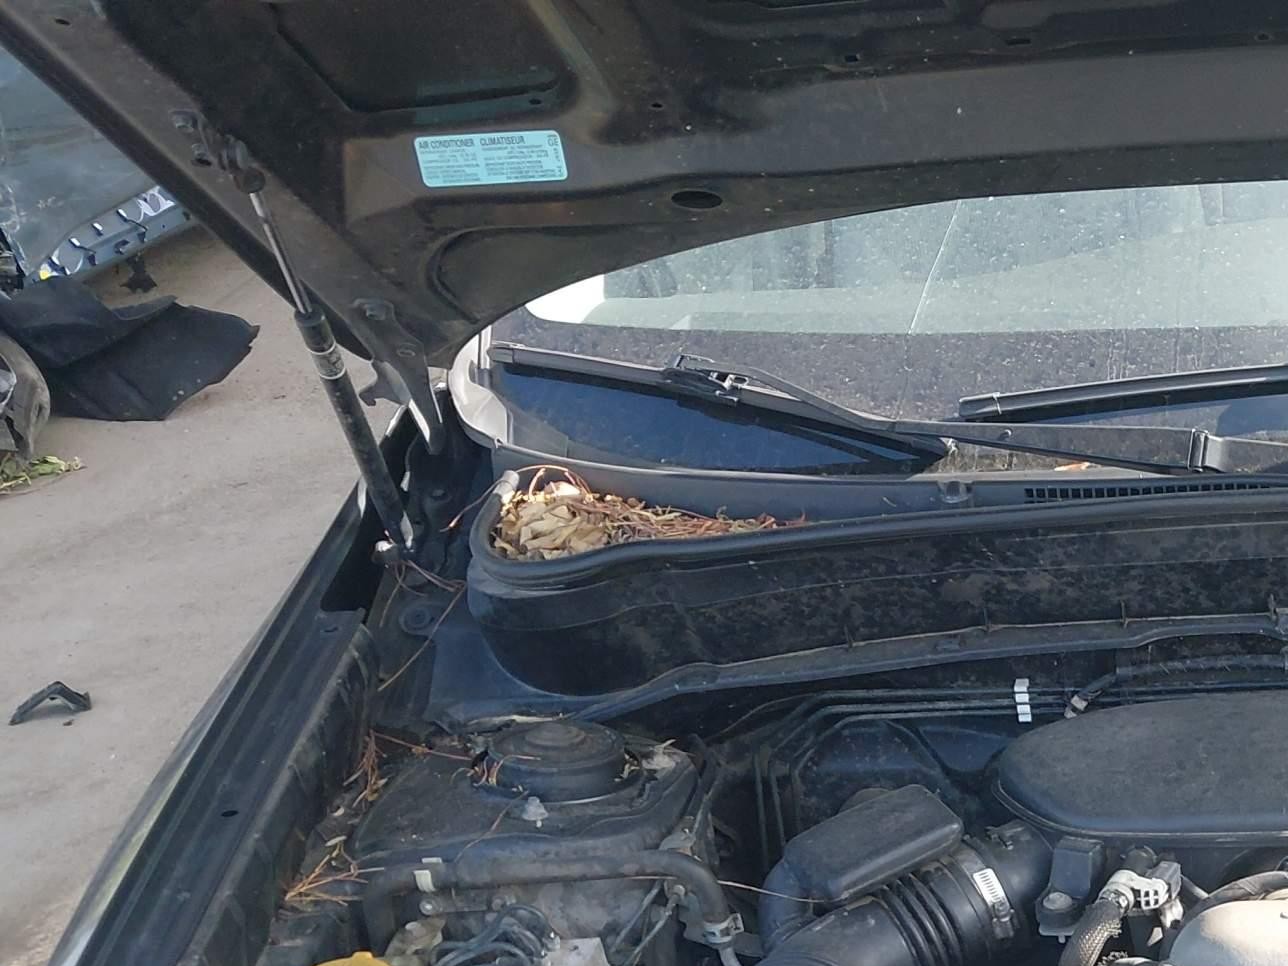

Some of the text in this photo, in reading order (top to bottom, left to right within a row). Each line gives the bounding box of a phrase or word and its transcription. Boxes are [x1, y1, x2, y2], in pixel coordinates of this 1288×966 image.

[419, 138, 475, 149] AIR CONDITIONER
[479, 135, 526, 146] CLIMATISEUR
